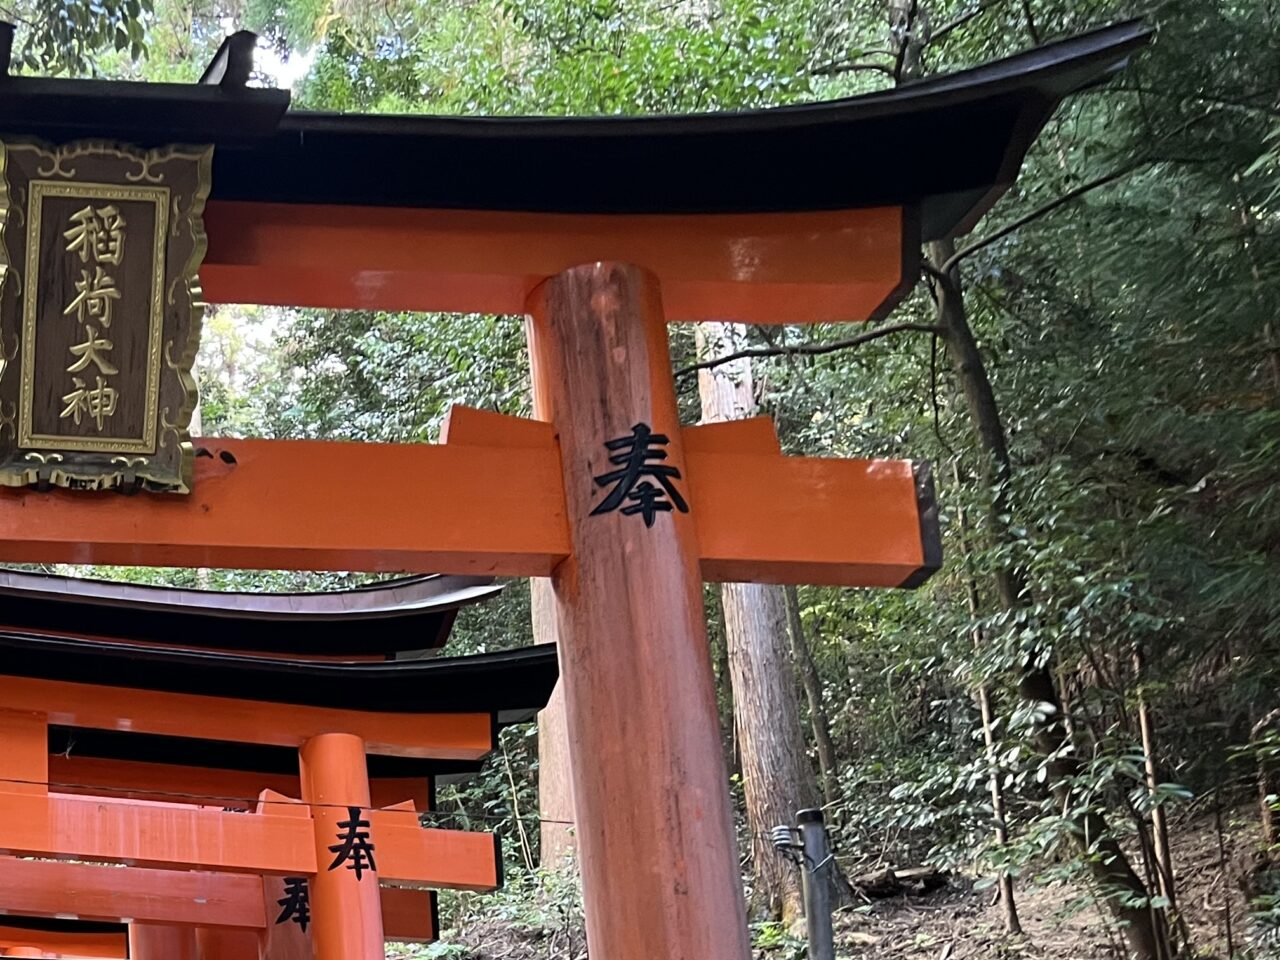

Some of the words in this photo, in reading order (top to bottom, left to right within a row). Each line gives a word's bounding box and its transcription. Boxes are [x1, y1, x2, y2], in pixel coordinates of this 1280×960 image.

[588, 422, 689, 529] 奉
[327, 807, 377, 881] 奉
[275, 877, 311, 933] 奉
